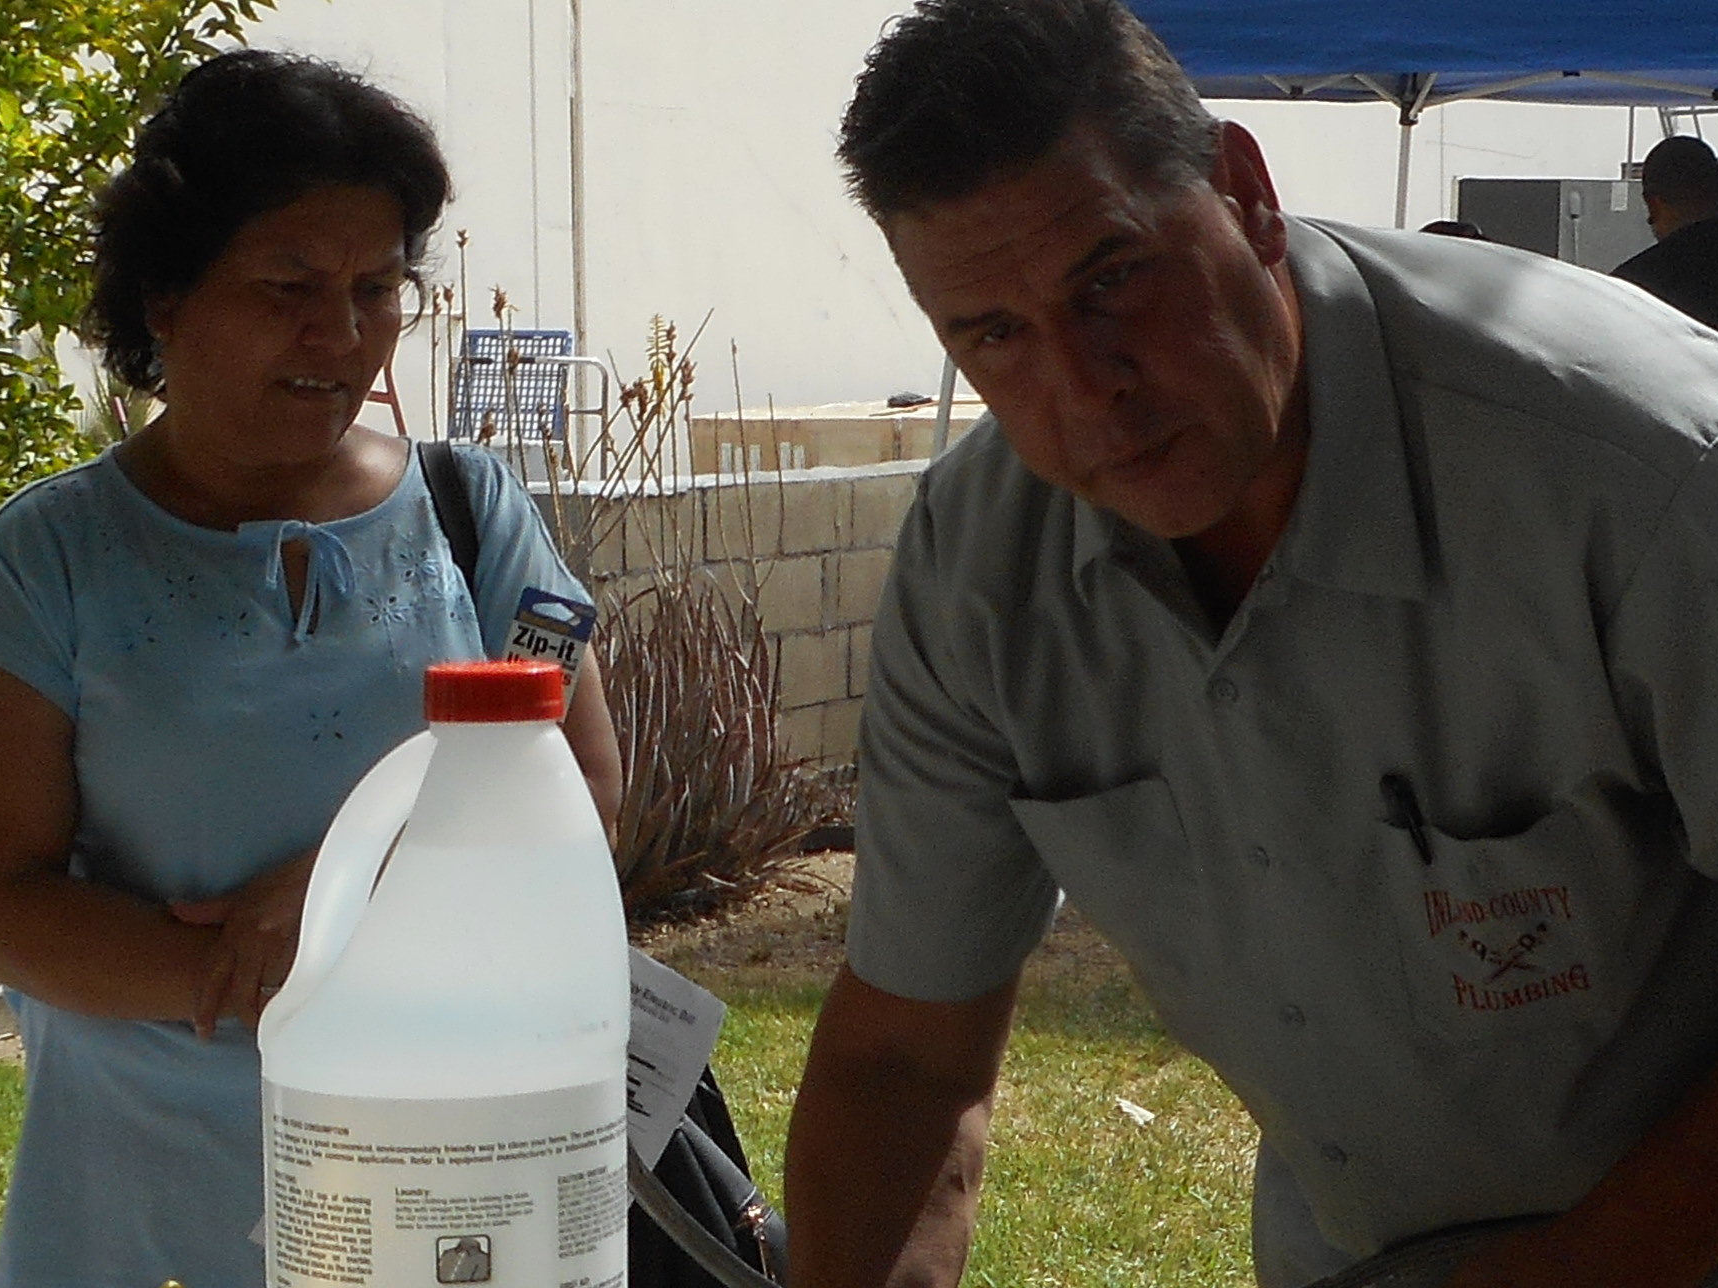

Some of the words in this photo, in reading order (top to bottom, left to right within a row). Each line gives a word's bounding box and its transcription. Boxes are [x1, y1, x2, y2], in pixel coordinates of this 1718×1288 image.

[513, 624, 575, 662] Zip-it
[1488, 885, 1573, 920] COUNTY
[1451, 963, 1593, 1012] PLUMBING
[444, 1145, 476, 1153] friendly
